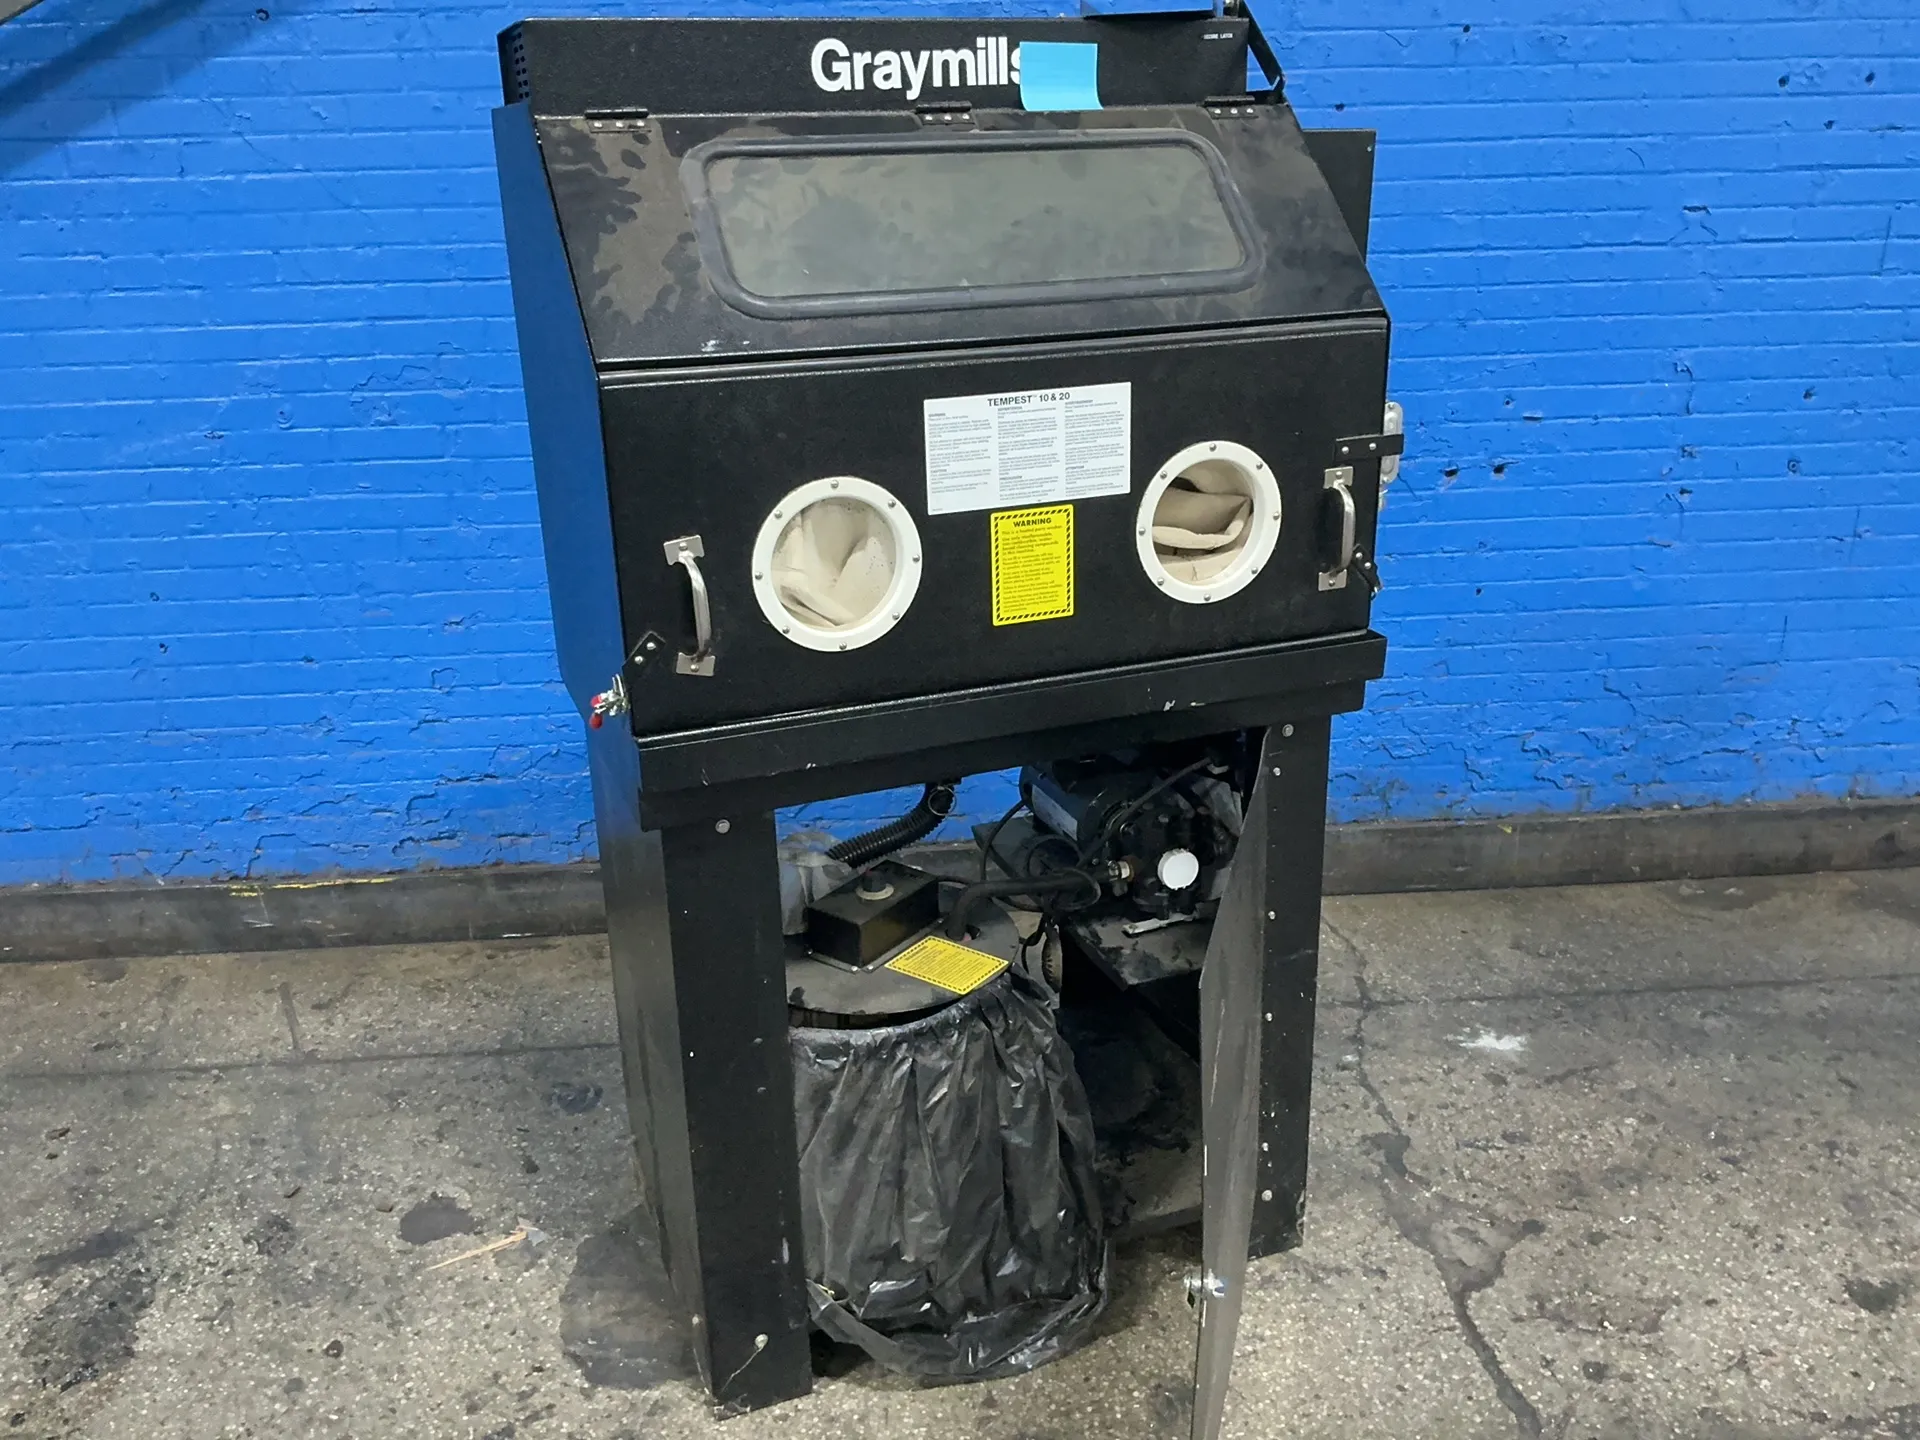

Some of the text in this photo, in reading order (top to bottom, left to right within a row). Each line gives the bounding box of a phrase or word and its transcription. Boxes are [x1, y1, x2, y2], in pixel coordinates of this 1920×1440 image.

[1039, 394, 1049, 403] 10
[1059, 392, 1071, 401] 20
[1013, 517, 1052, 528] WARNING
